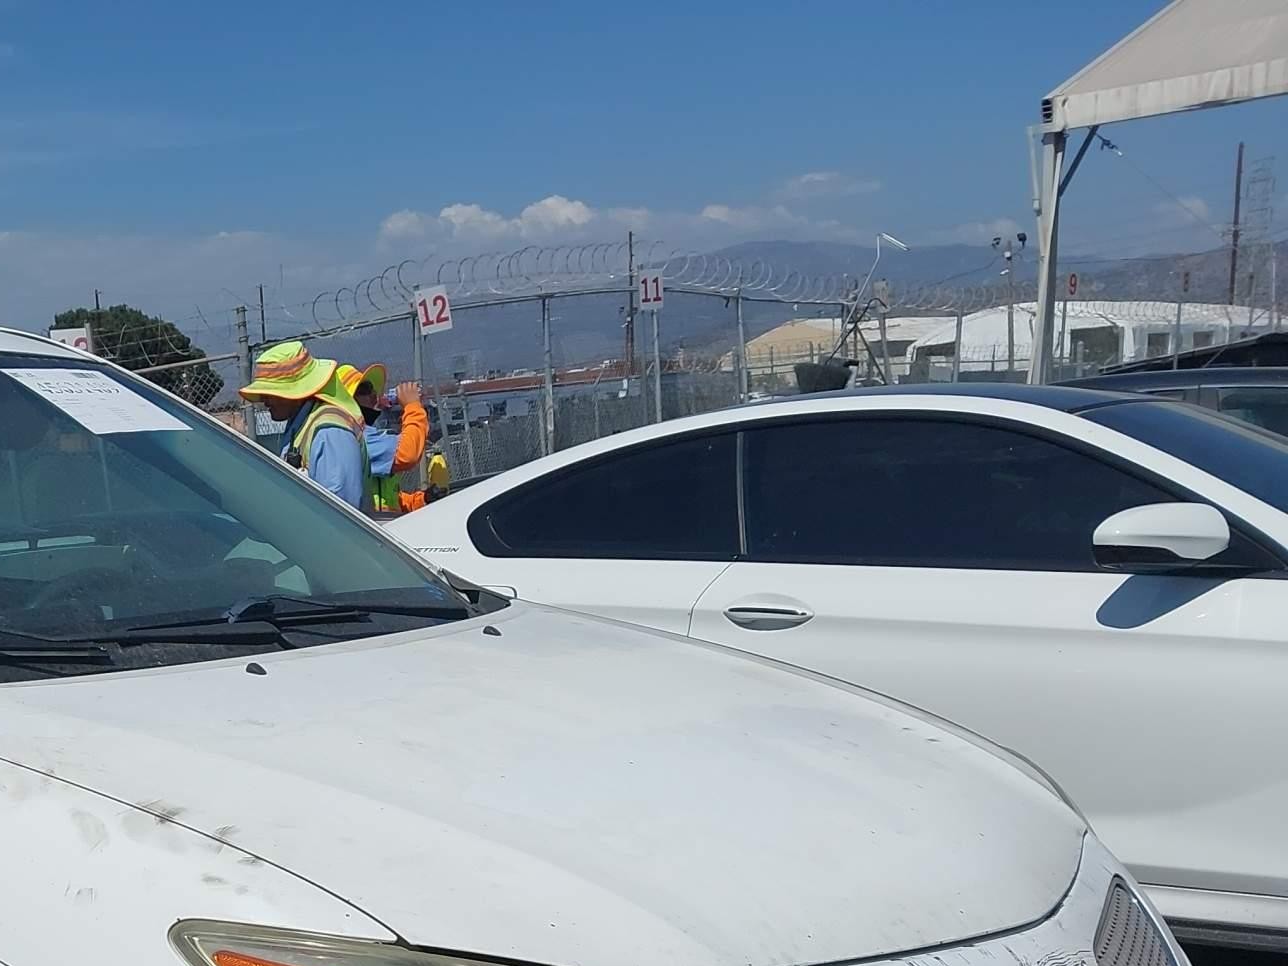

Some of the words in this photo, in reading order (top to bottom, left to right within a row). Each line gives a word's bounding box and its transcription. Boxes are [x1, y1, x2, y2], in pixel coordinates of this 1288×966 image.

[641, 276, 662, 303] 11
[1069, 273, 1076, 295] 9
[418, 295, 449, 327] 12
